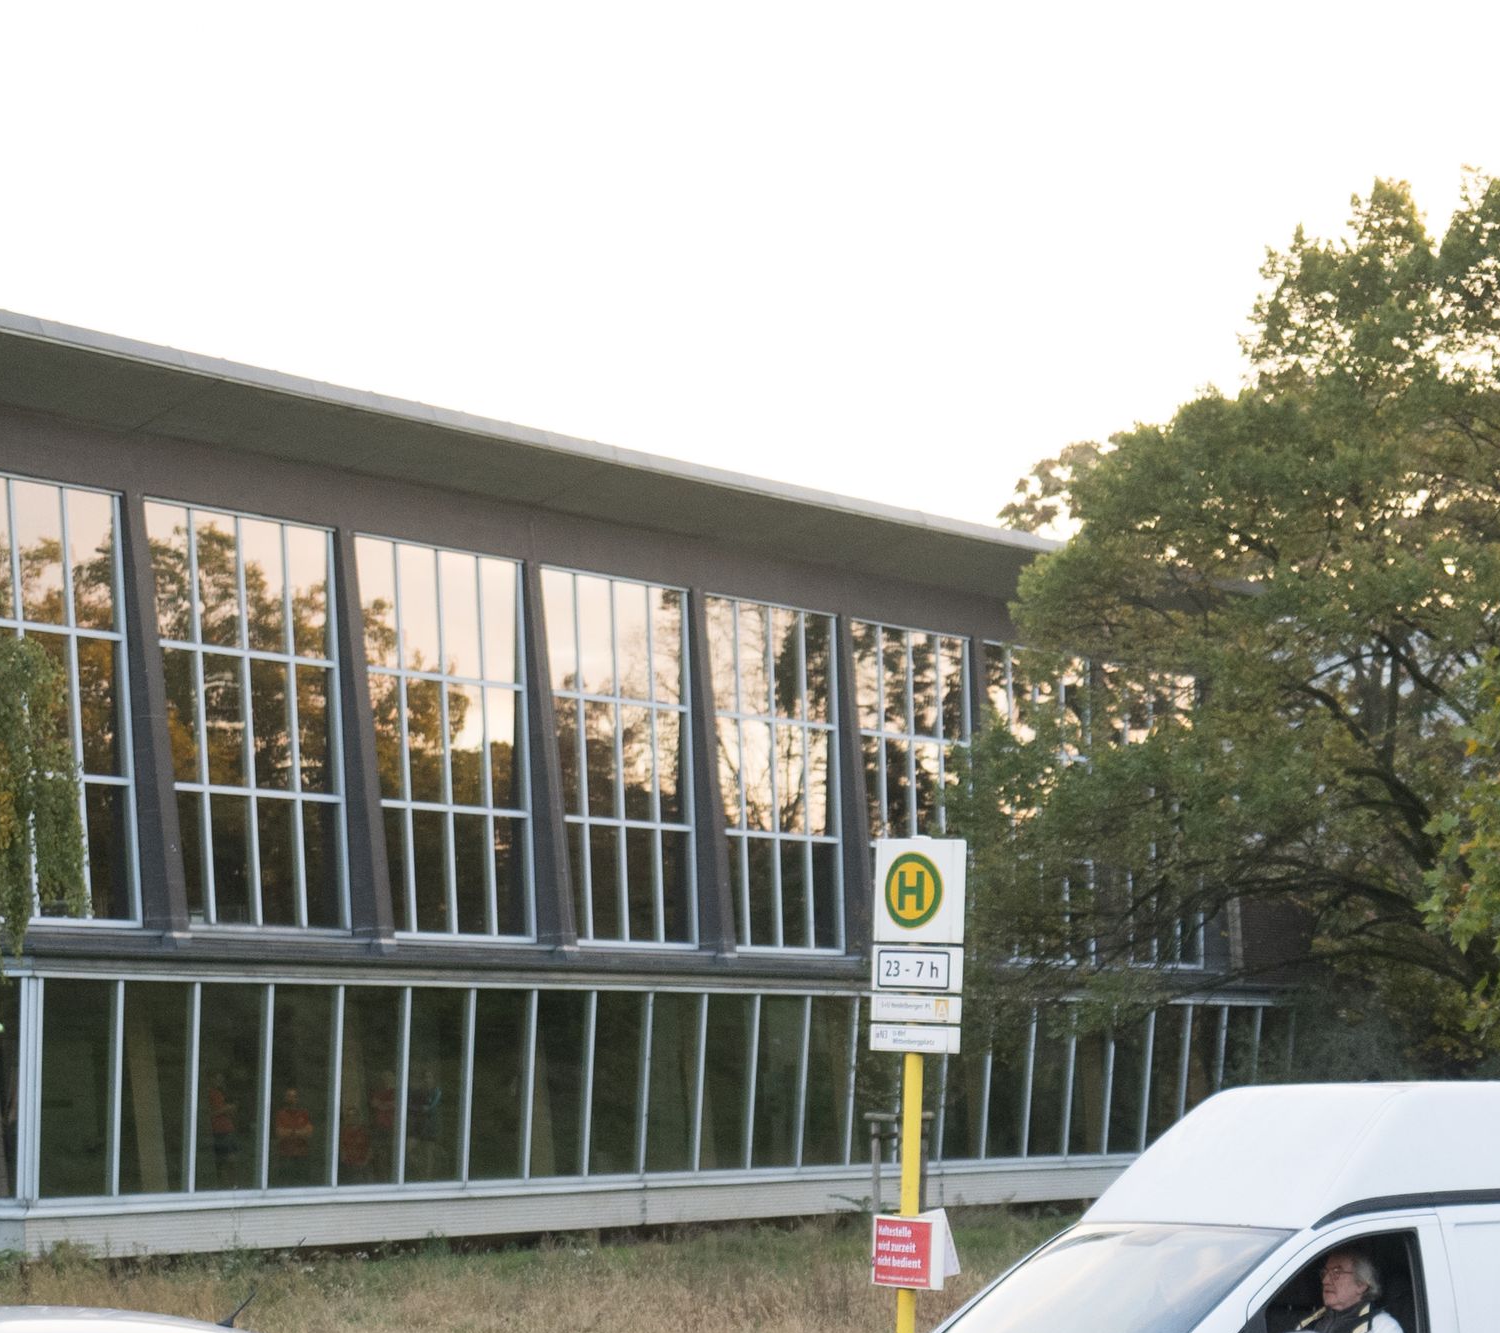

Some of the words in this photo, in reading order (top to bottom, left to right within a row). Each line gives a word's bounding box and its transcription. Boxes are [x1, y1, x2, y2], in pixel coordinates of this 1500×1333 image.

[898, 871, 924, 911] H
[886, 960, 900, 978] 23
[916, 961, 924, 978] 7
[930, 961, 939, 979] h
[878, 1225, 912, 1238] Haltestelle
[878, 1240, 891, 1251] wird
[891, 1242, 916, 1254] zurzeit
[877, 1256, 891, 1267] nicht
[891, 1256, 921, 1269] bedient
